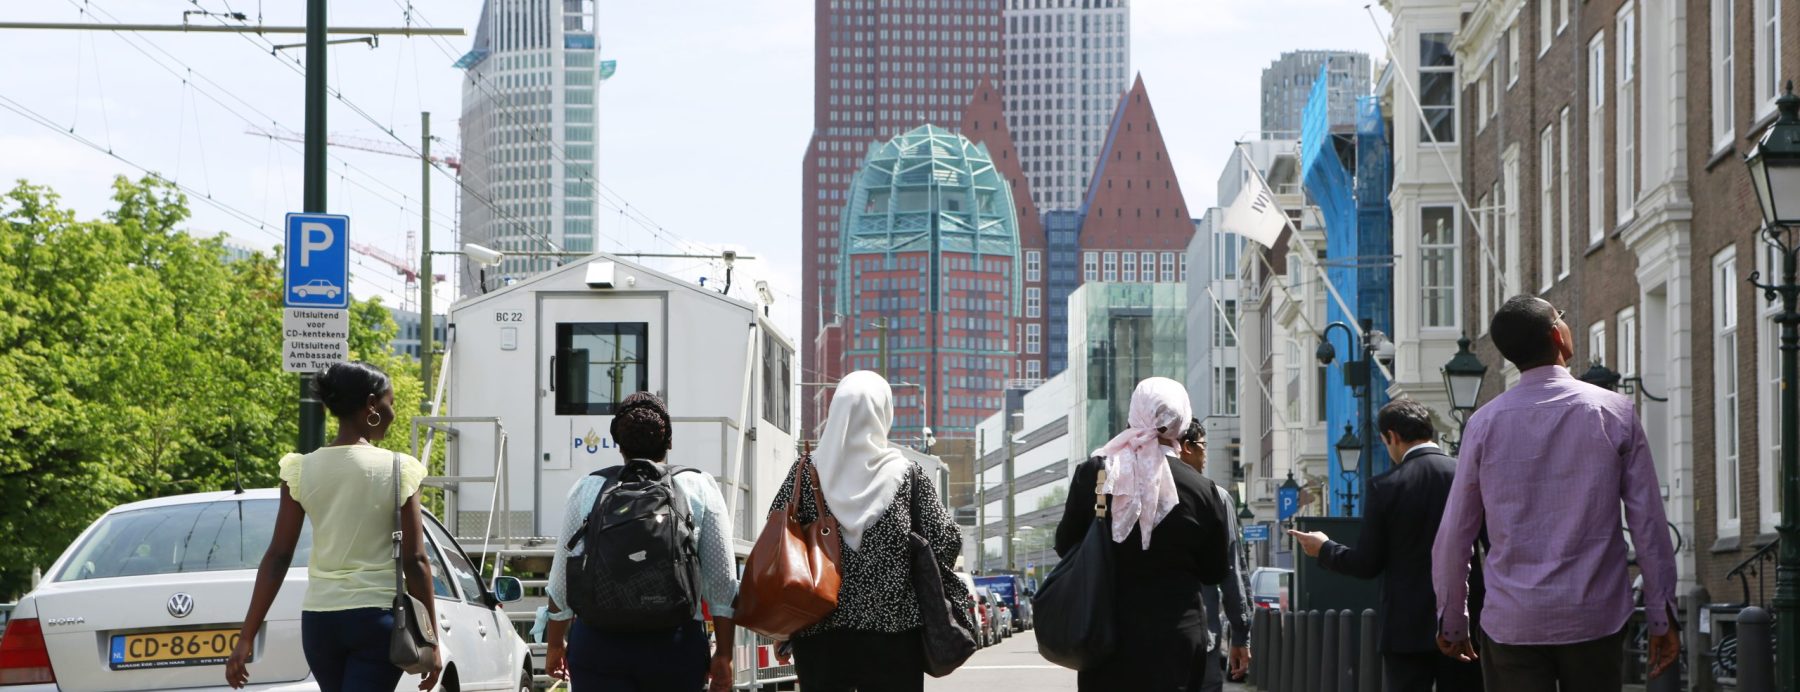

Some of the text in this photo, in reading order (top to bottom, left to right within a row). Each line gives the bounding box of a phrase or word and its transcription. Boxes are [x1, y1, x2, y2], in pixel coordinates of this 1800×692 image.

[300, 222, 334, 268] P
[293, 311, 339, 319] Uitsluitend
[496, 312, 523, 322] BC 22
[286, 330, 346, 338] CD-kentekens
[291, 342, 340, 350] Uitsluitend
[289, 352, 342, 360] Ambassade
[1284, 497, 1292, 511] P
[48, 616, 85, 627] BORA
